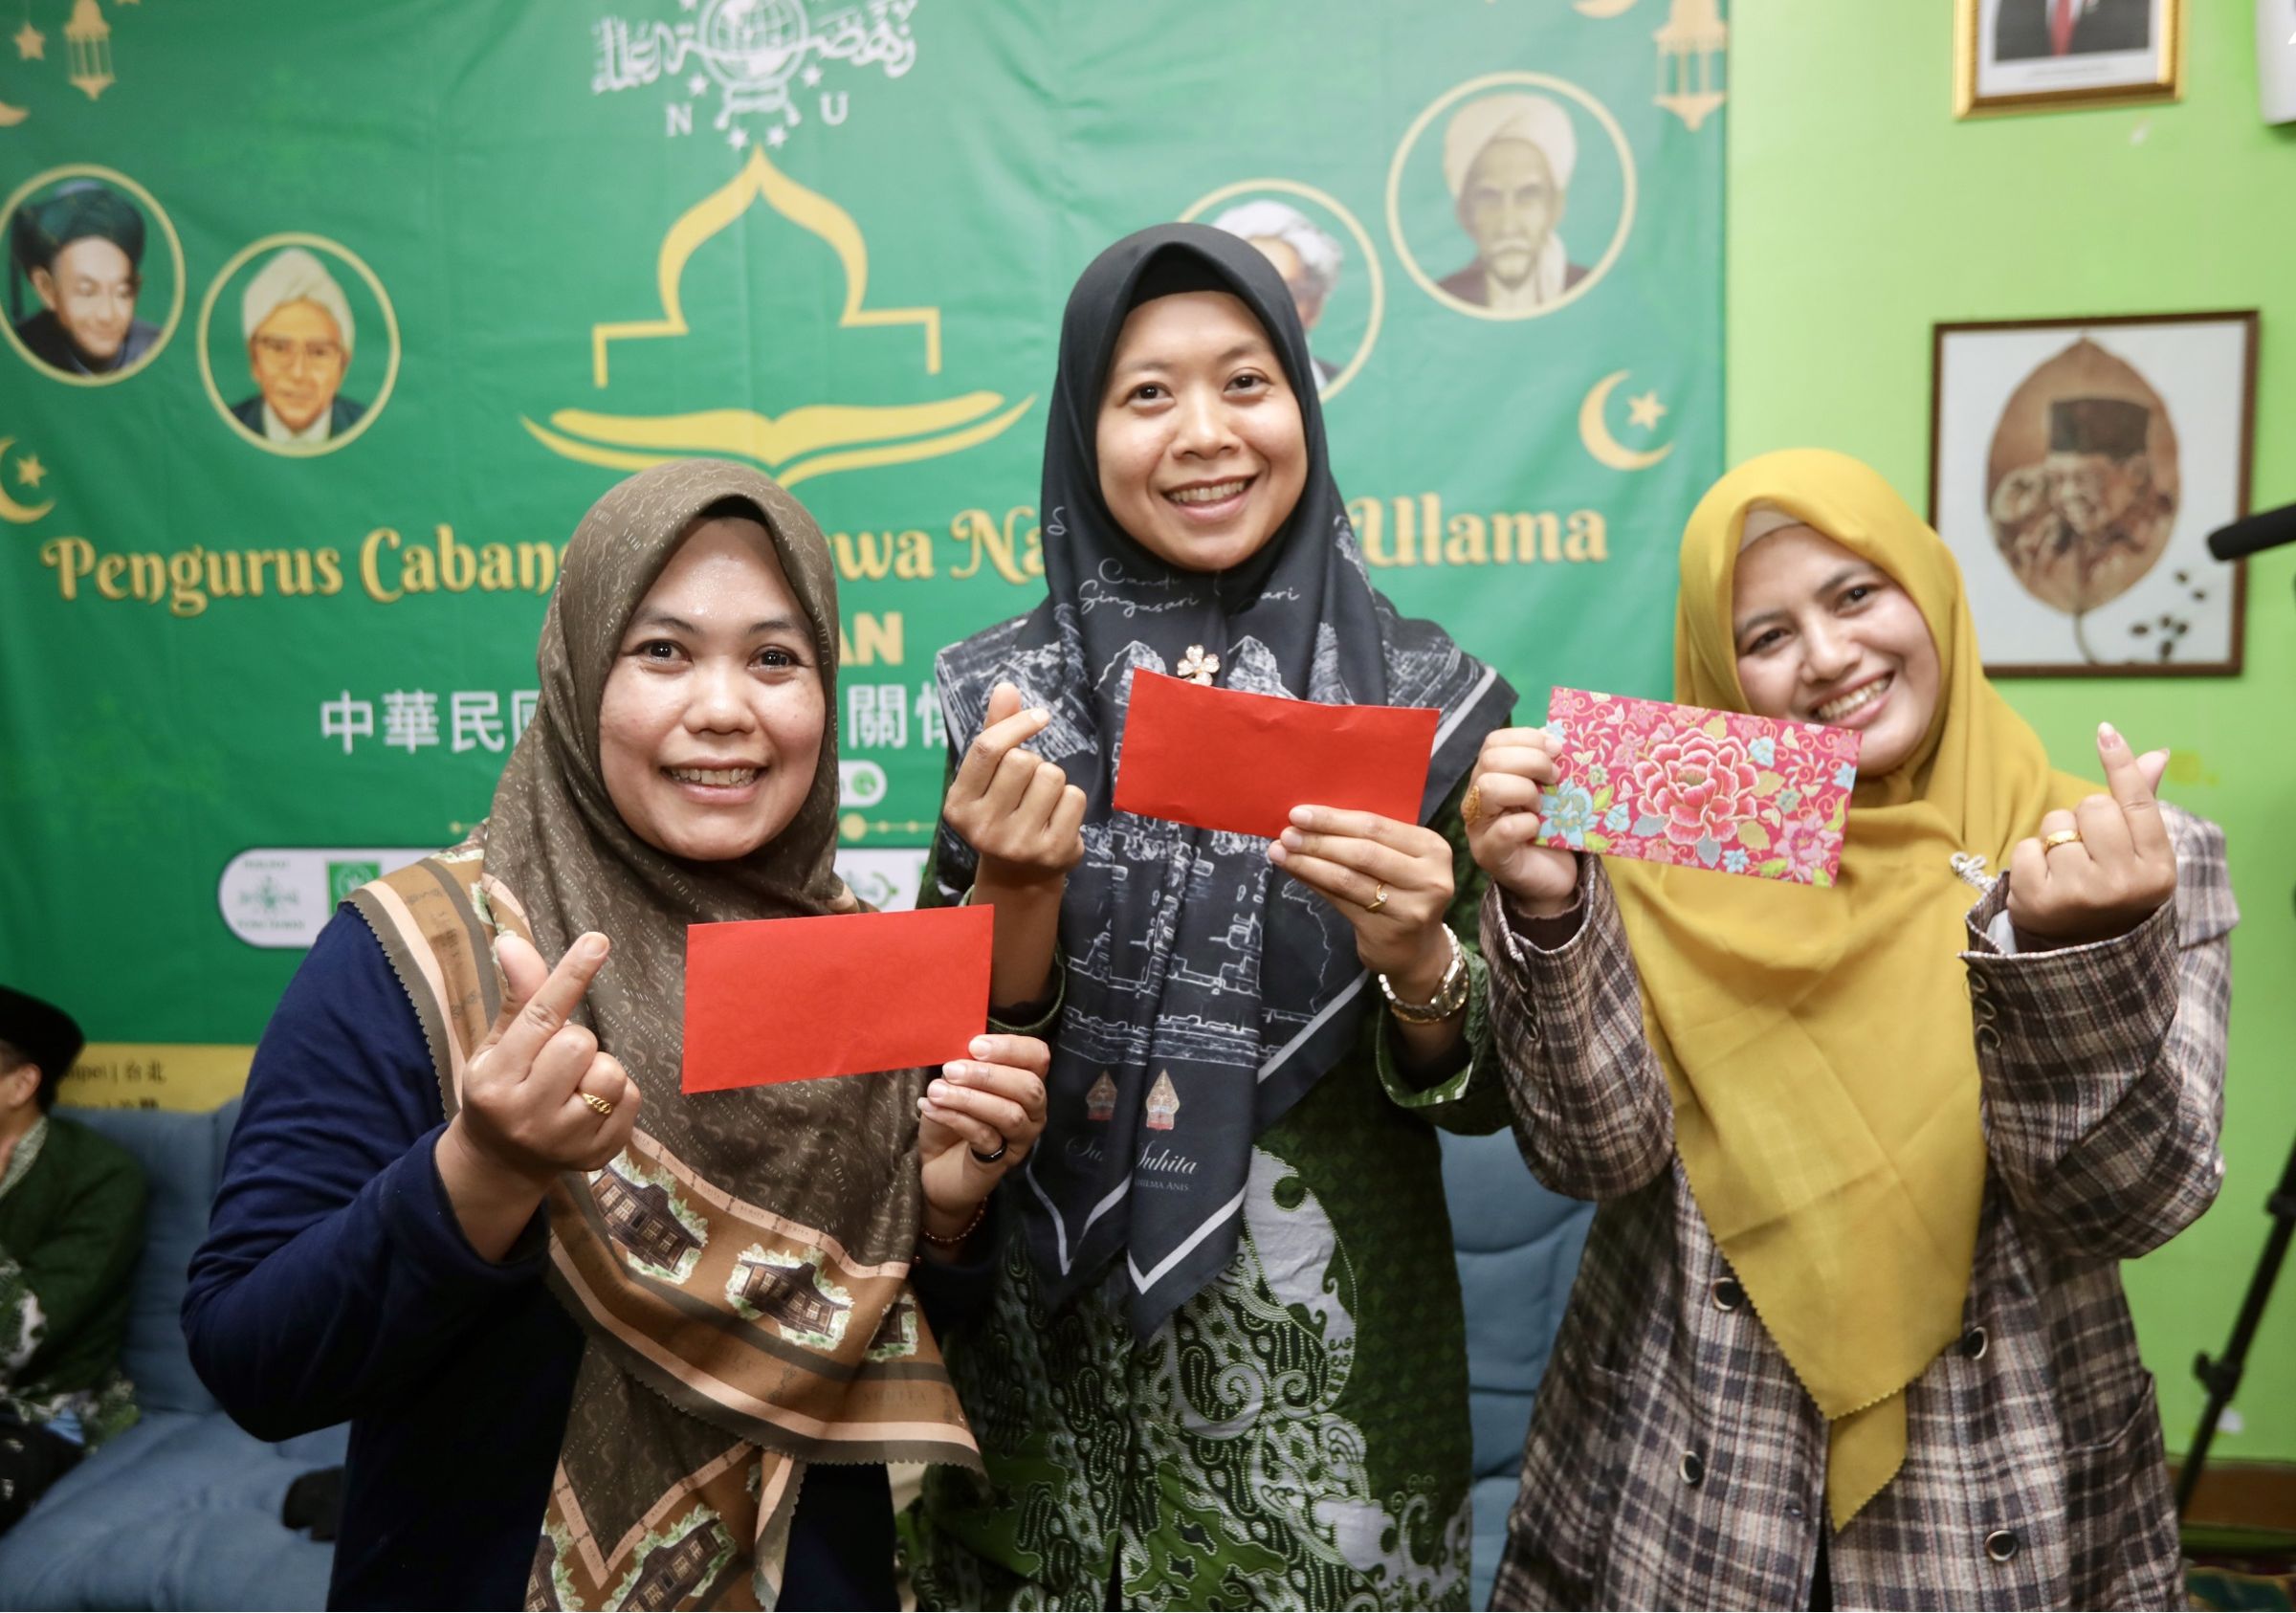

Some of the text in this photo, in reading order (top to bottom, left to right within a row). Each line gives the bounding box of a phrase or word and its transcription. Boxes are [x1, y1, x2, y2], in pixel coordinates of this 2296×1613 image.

[666, 91, 850, 138] N U
[41, 536, 343, 618] Pengurus
[360, 524, 570, 604] Caban
[1346, 491, 1609, 567] Ulama
[67, 1063, 107, 1082] aipei
